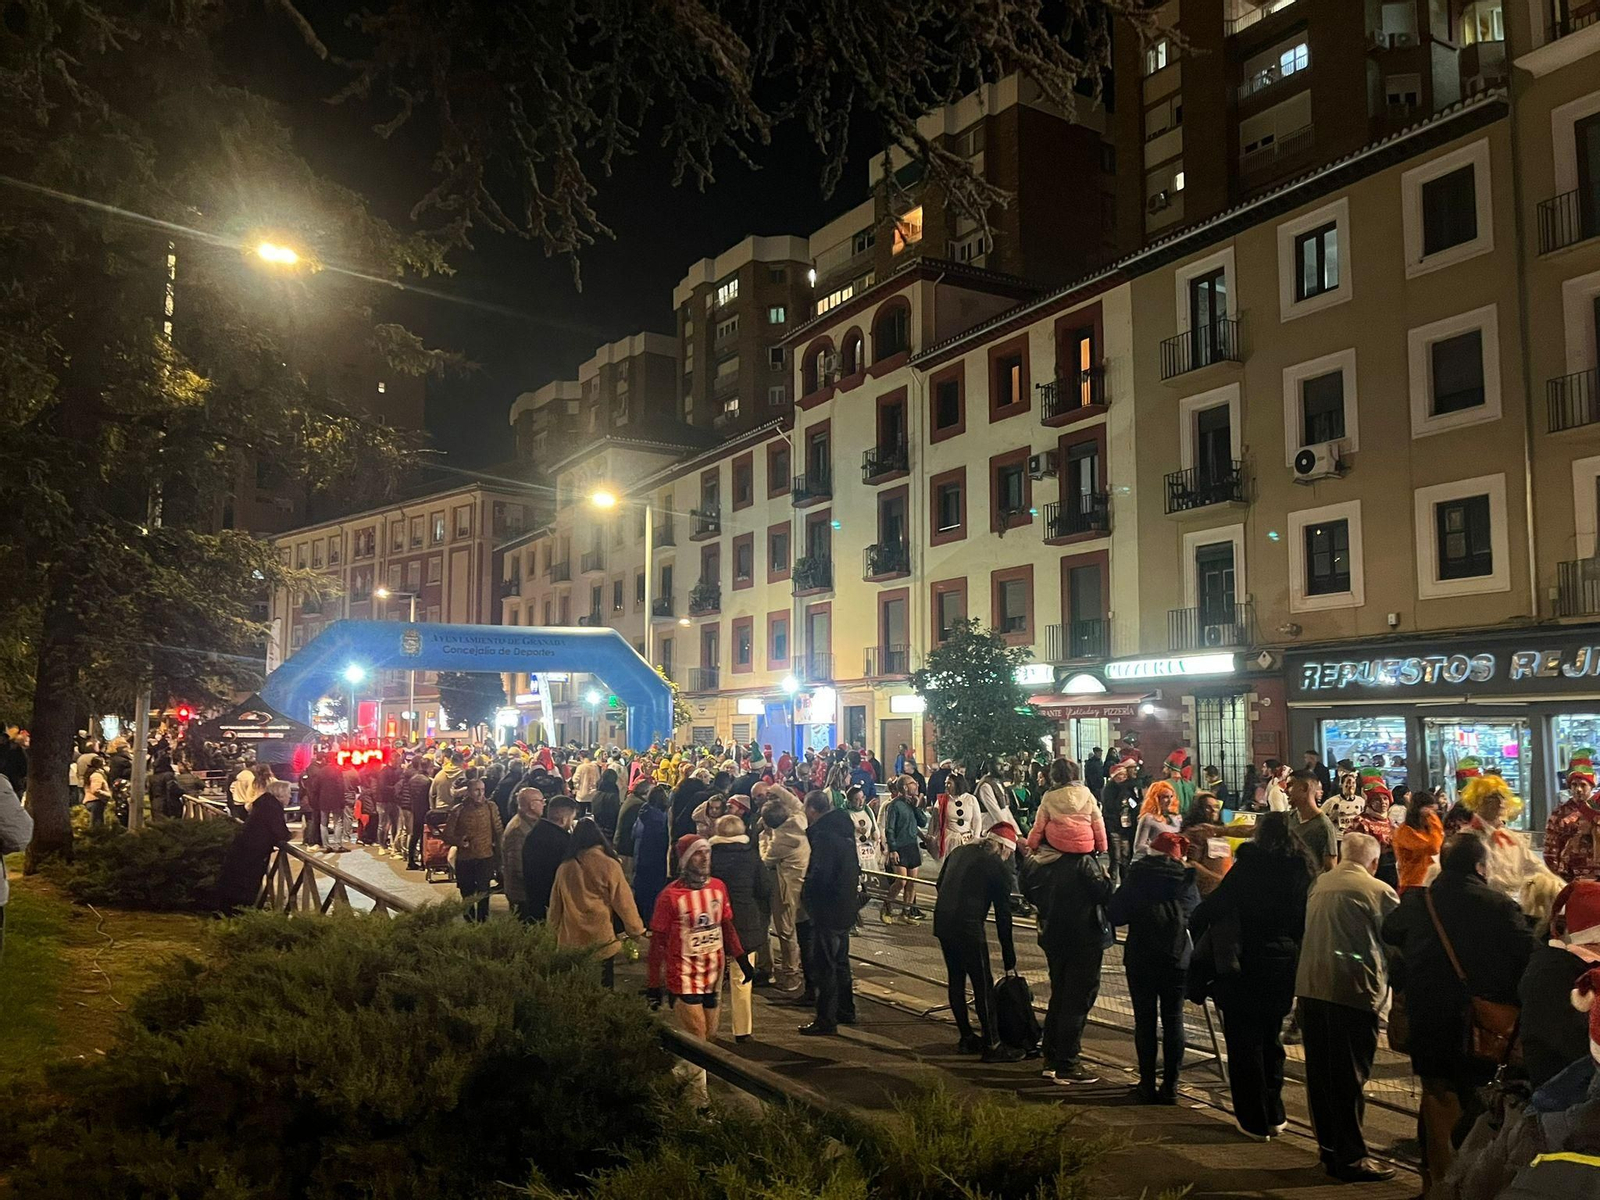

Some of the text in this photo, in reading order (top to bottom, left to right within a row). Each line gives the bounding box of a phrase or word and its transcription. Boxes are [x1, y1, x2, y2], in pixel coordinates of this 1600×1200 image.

[506, 637, 520, 646] DE
[522, 636, 566, 646] GRANADA
[498, 647, 510, 656] de
[513, 647, 555, 658] Deportes
[1300, 653, 1495, 690] REPUESTOS
